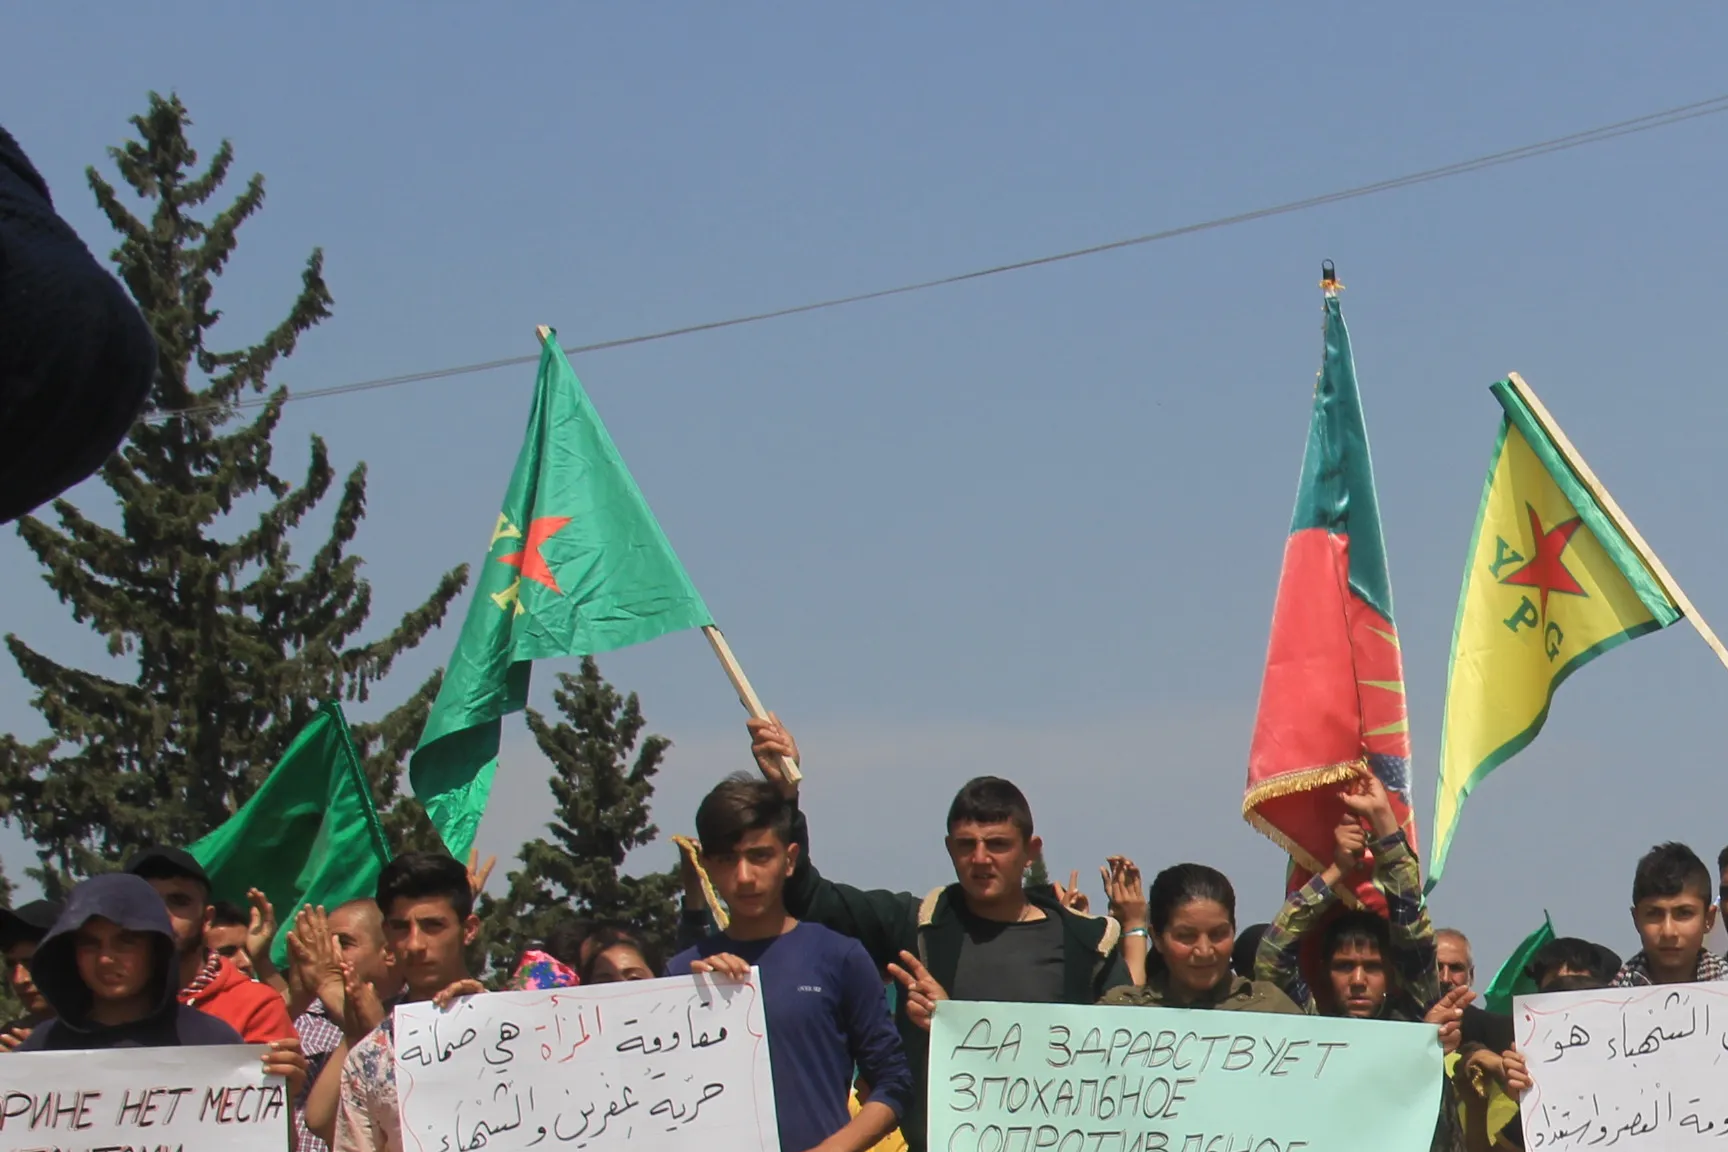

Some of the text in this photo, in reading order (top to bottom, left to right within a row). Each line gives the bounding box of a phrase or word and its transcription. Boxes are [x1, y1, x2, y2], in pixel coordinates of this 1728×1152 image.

[951, 1017, 1349, 1078] ДА ЗДРАВСТВУЕТ
[115, 1086, 194, 1129] НЕТ
[199, 1084, 285, 1124] МЕСТА
